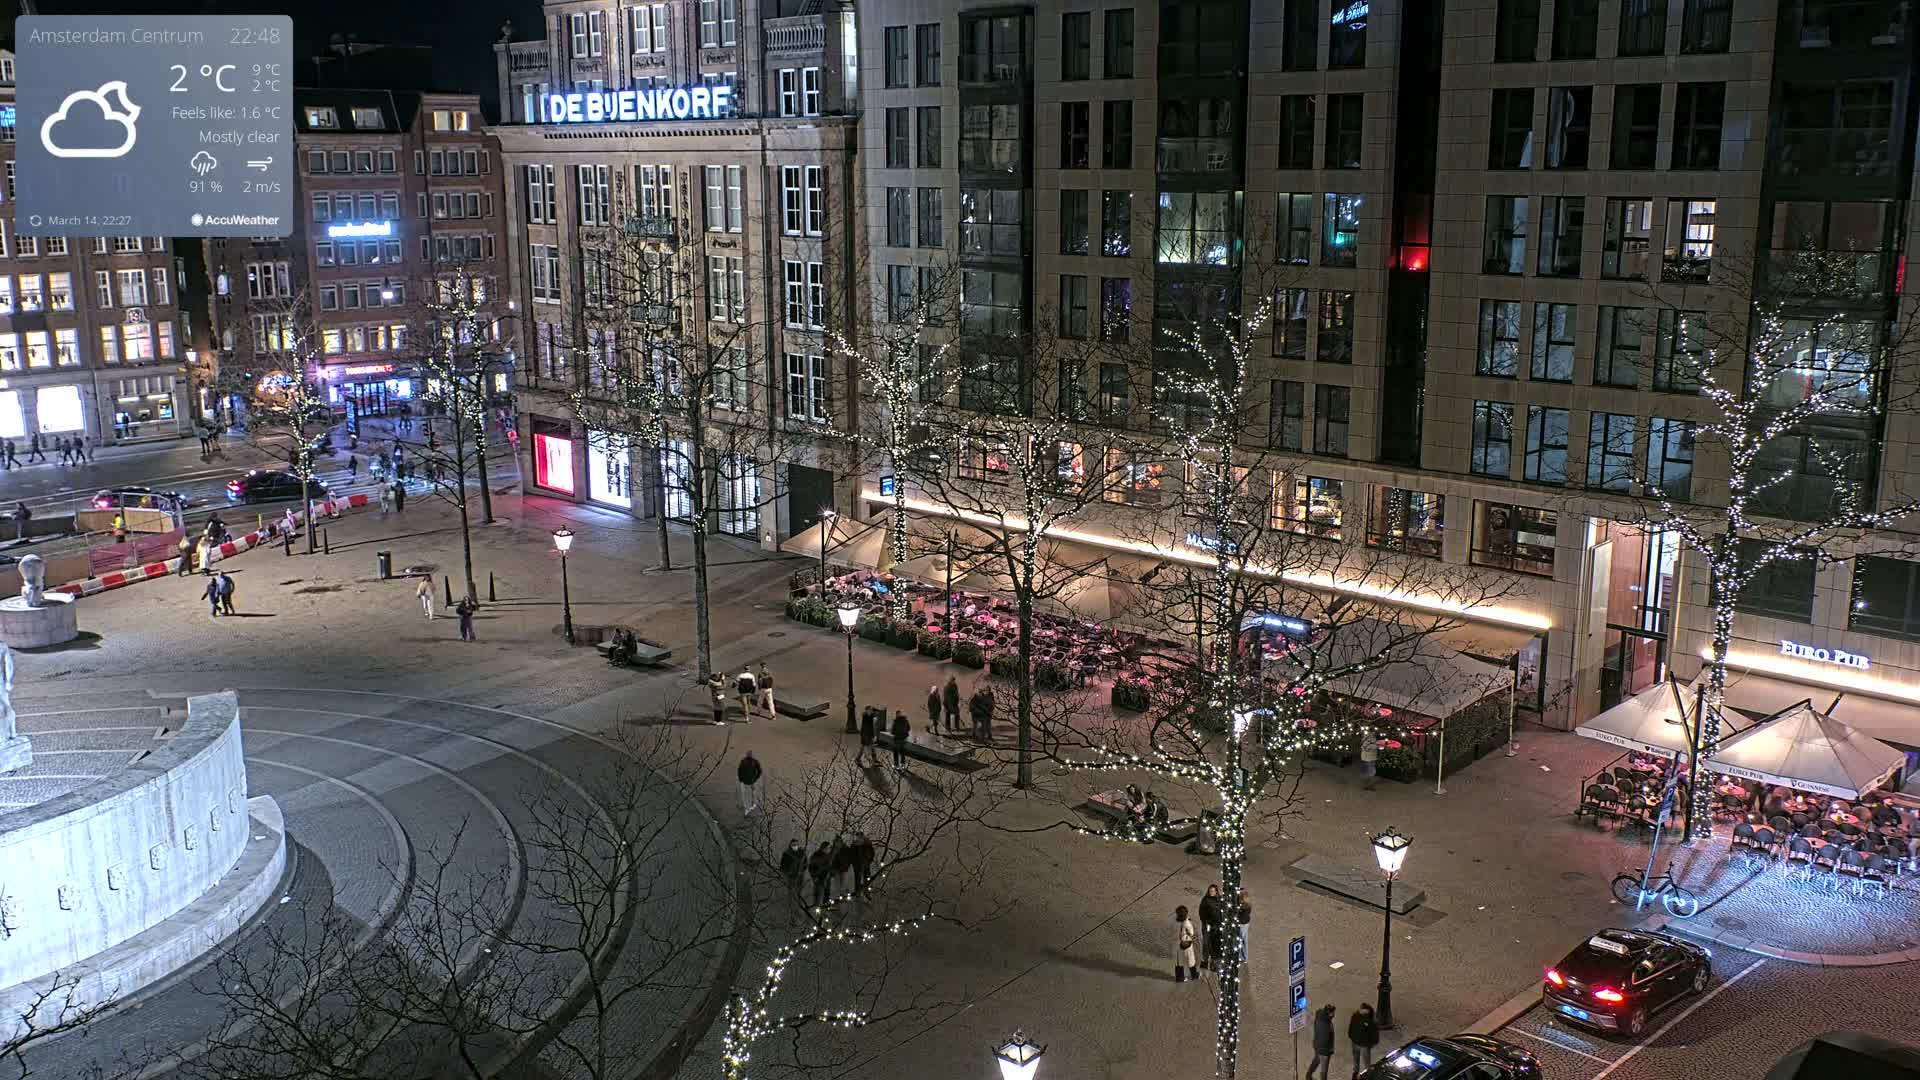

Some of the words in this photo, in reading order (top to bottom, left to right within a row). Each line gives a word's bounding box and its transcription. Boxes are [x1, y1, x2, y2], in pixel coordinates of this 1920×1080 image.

[550, 94, 583, 122] DE
[1780, 640, 1829, 662] EURO
[1834, 649, 1870, 670] PUB
[1293, 942, 1302, 961] P
[1294, 985, 1303, 1002] P
